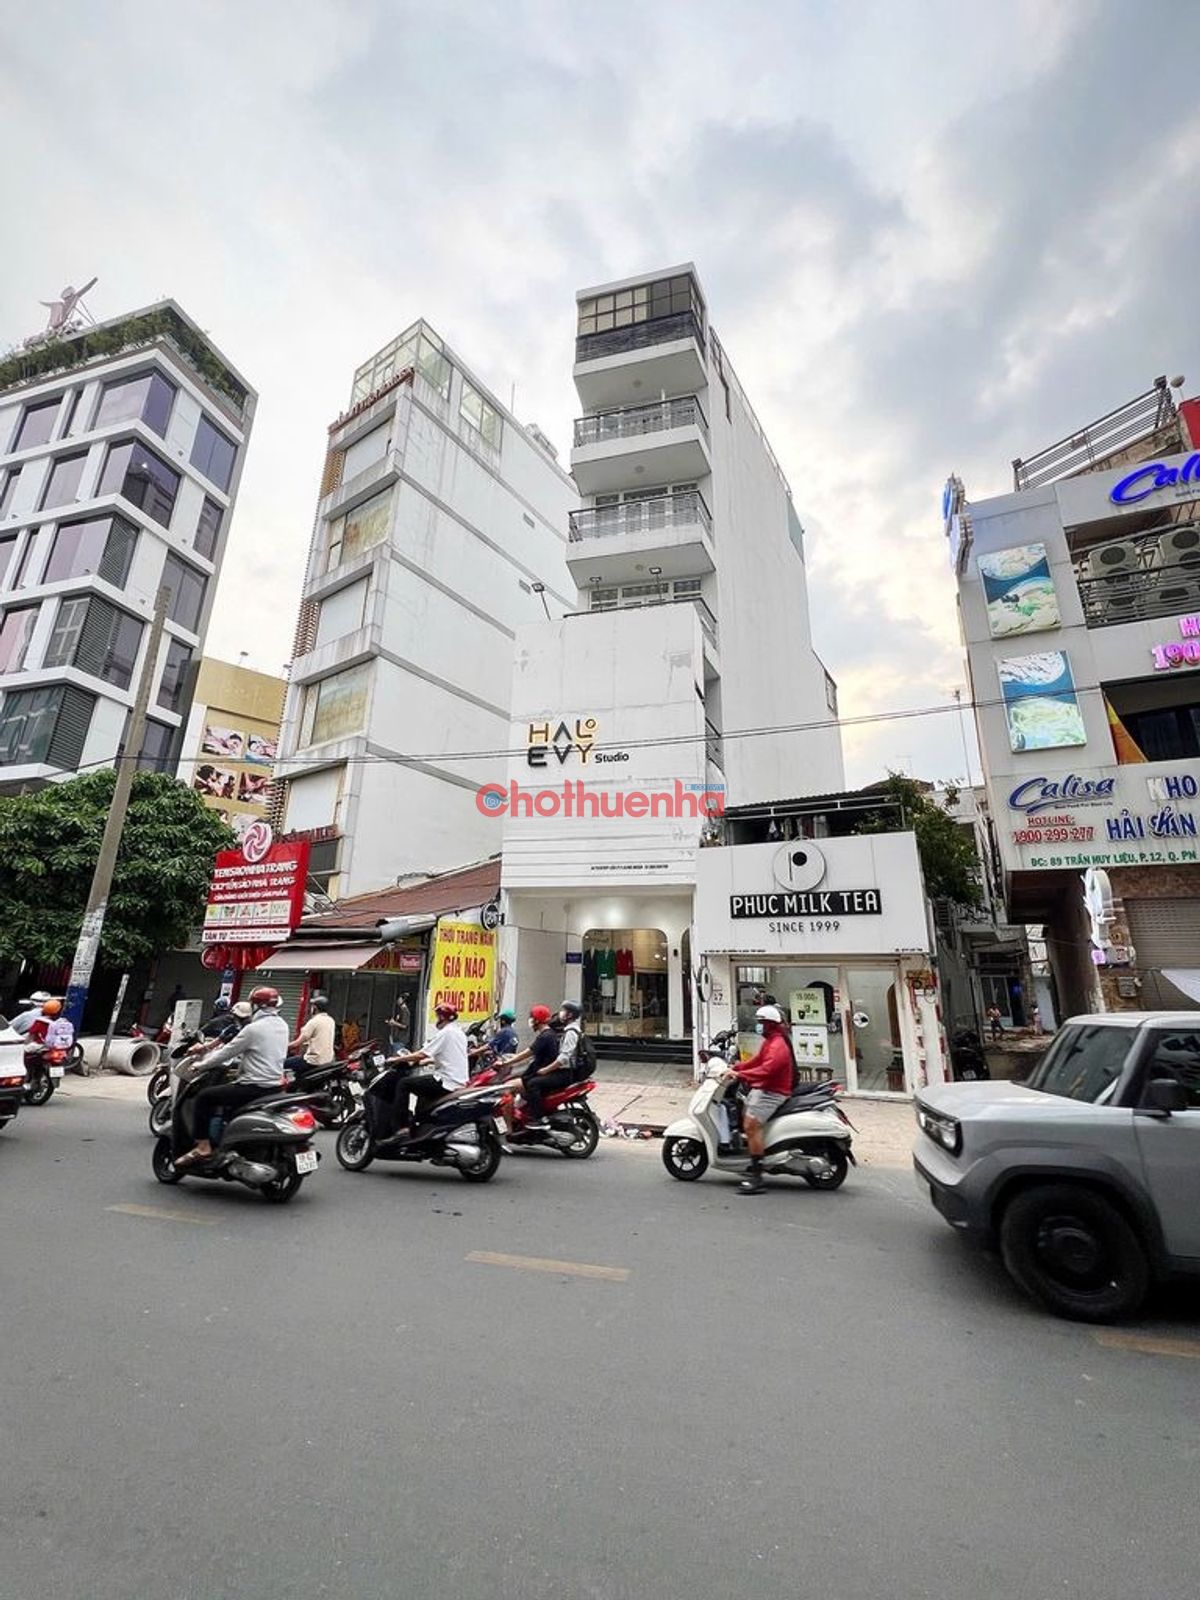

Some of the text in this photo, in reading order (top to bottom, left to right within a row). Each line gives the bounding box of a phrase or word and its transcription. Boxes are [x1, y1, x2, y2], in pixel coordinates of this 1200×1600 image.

[529, 718, 597, 743] HALO
[528, 743, 630, 767] EVY Studio
[1009, 774, 1116, 813] Calisa
[1027, 814, 1076, 827] HOTLINE:
[1106, 809, 1145, 840] HẢI
[1013, 826, 1094, 844] 1900 299 277
[1050, 857, 1062, 867] 89
[1092, 854, 1111, 865] HUY
[732, 890, 878, 915] PHUC MILK TEA
[769, 920, 840, 933] SINCE 1999
[443, 950, 461, 978] GIÁ
[464, 951, 486, 979] NÀO
[468, 985, 489, 1013] BÁN
